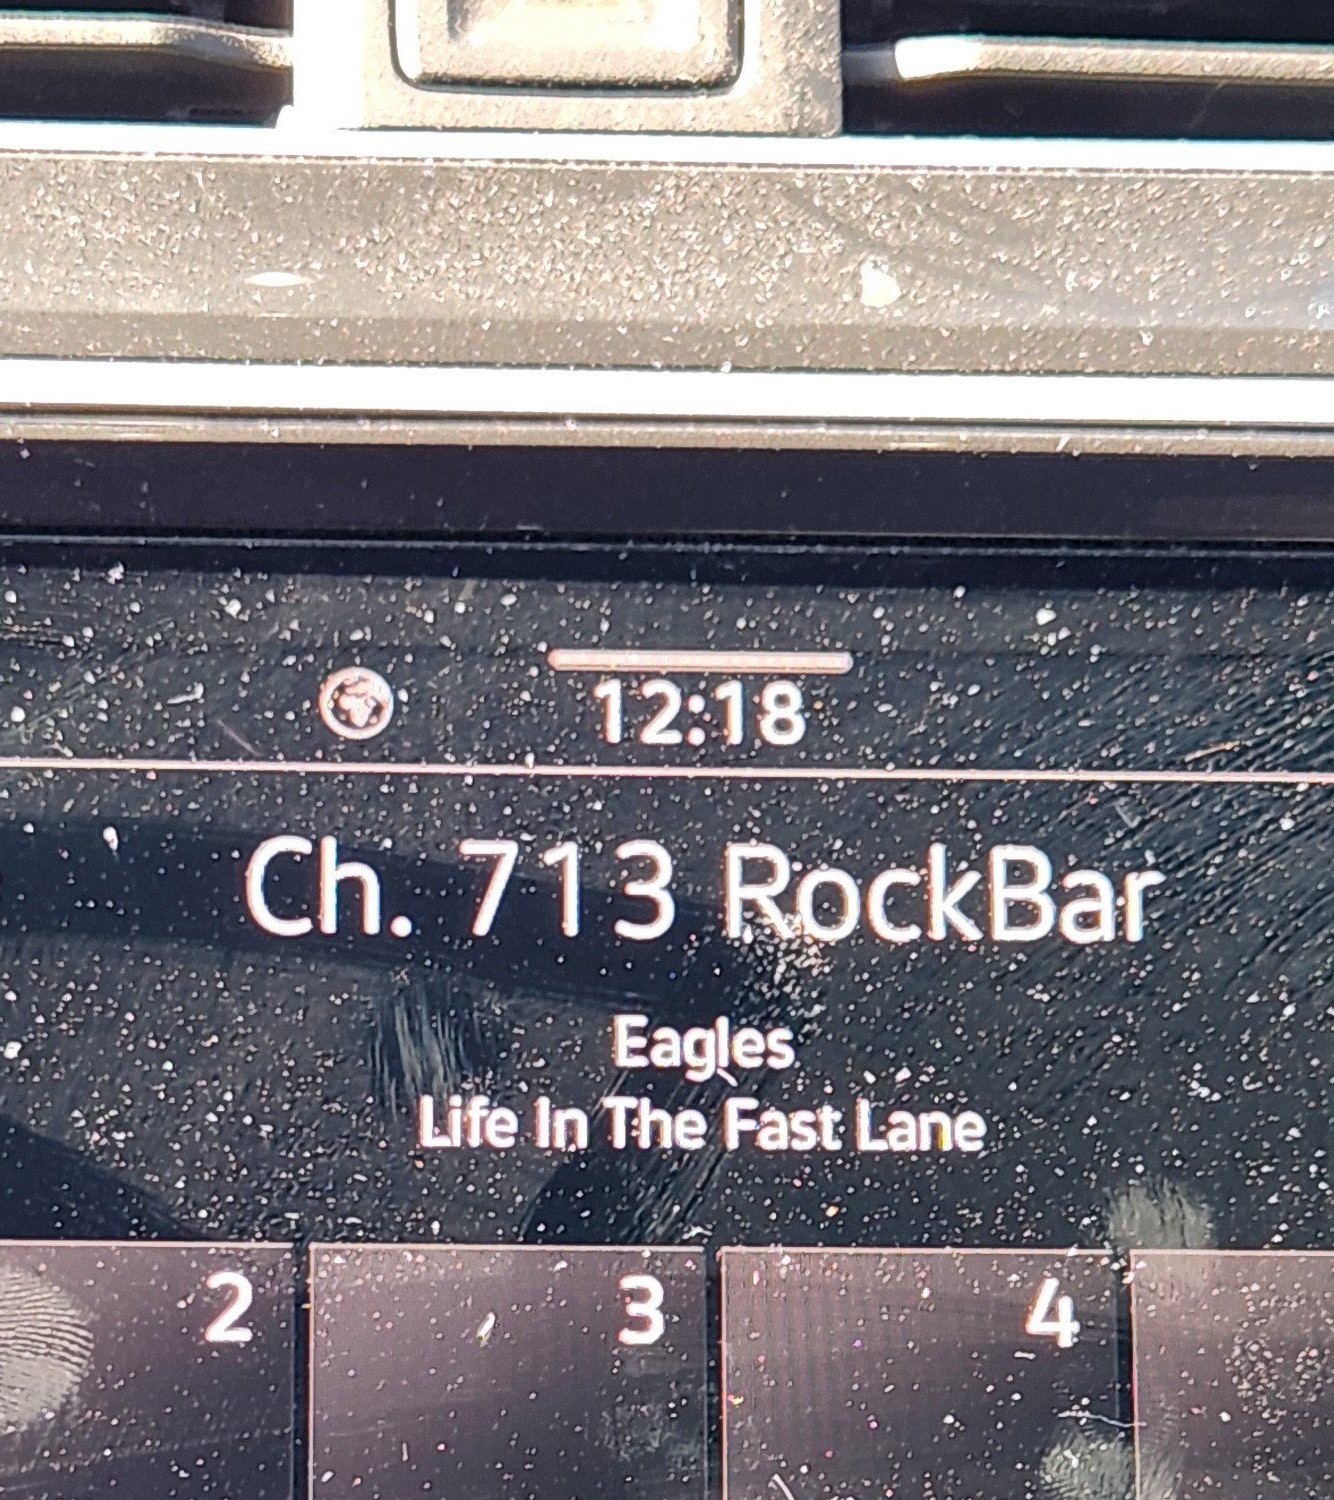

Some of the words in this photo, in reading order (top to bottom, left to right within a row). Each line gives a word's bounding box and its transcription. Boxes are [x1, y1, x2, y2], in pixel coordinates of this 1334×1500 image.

[594, 678, 808, 747] 12:18
[245, 834, 414, 939] Ch.
[460, 838, 675, 940] 713
[723, 842, 1167, 946] RockBar
[613, 1013, 795, 1080] Eagles
[418, 1096, 517, 1151] Life
[535, 1096, 590, 1151] In
[602, 1096, 708, 1152] The
[724, 1097, 843, 1153] Fast
[857, 1099, 986, 1154] Lane
[203, 1270, 255, 1344] 2
[618, 1273, 667, 1346] 3
[1024, 1277, 1081, 1350] 4
